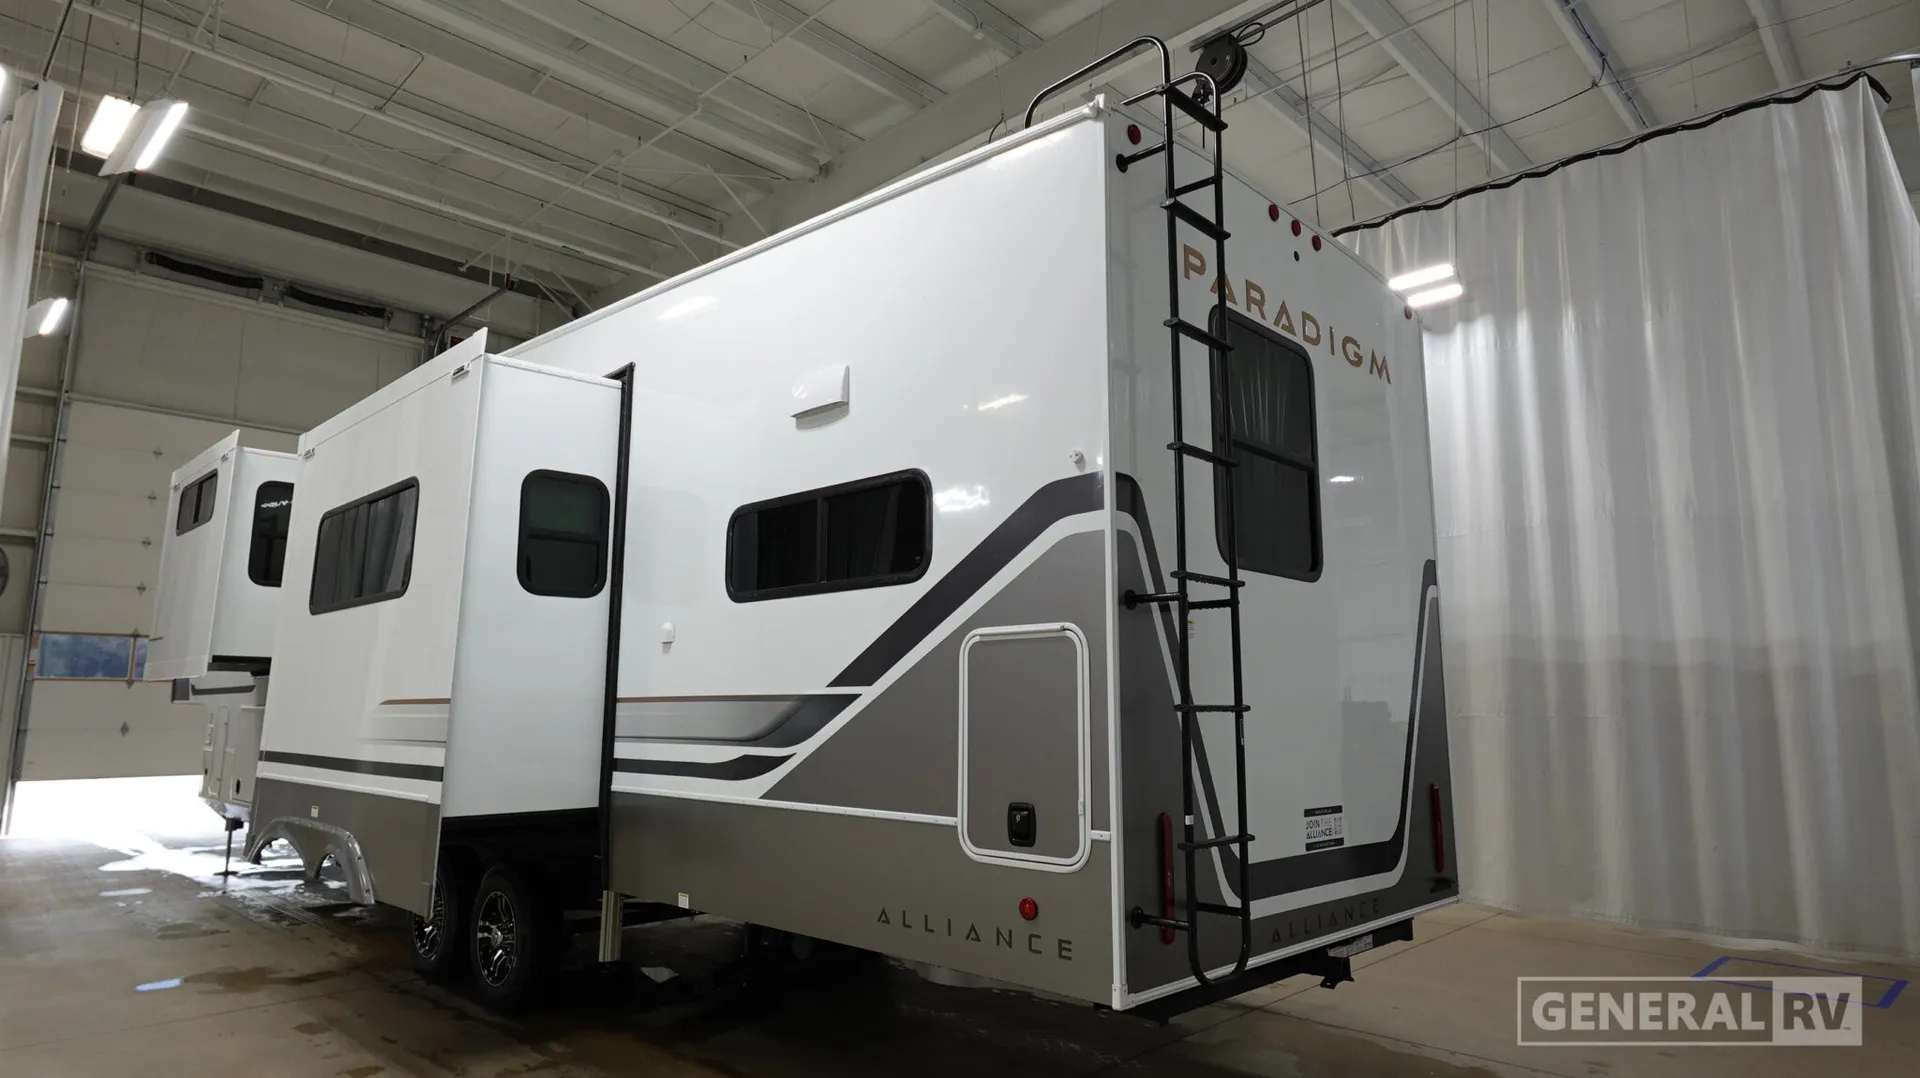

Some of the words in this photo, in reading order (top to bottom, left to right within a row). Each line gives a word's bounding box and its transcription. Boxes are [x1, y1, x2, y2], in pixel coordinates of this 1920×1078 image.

[1183, 243, 1392, 385] PARADIGM
[1305, 819, 1320, 830] JOIN
[877, 907, 1072, 961] ALLIANCE
[1272, 898, 1381, 942] ALLIANCE
